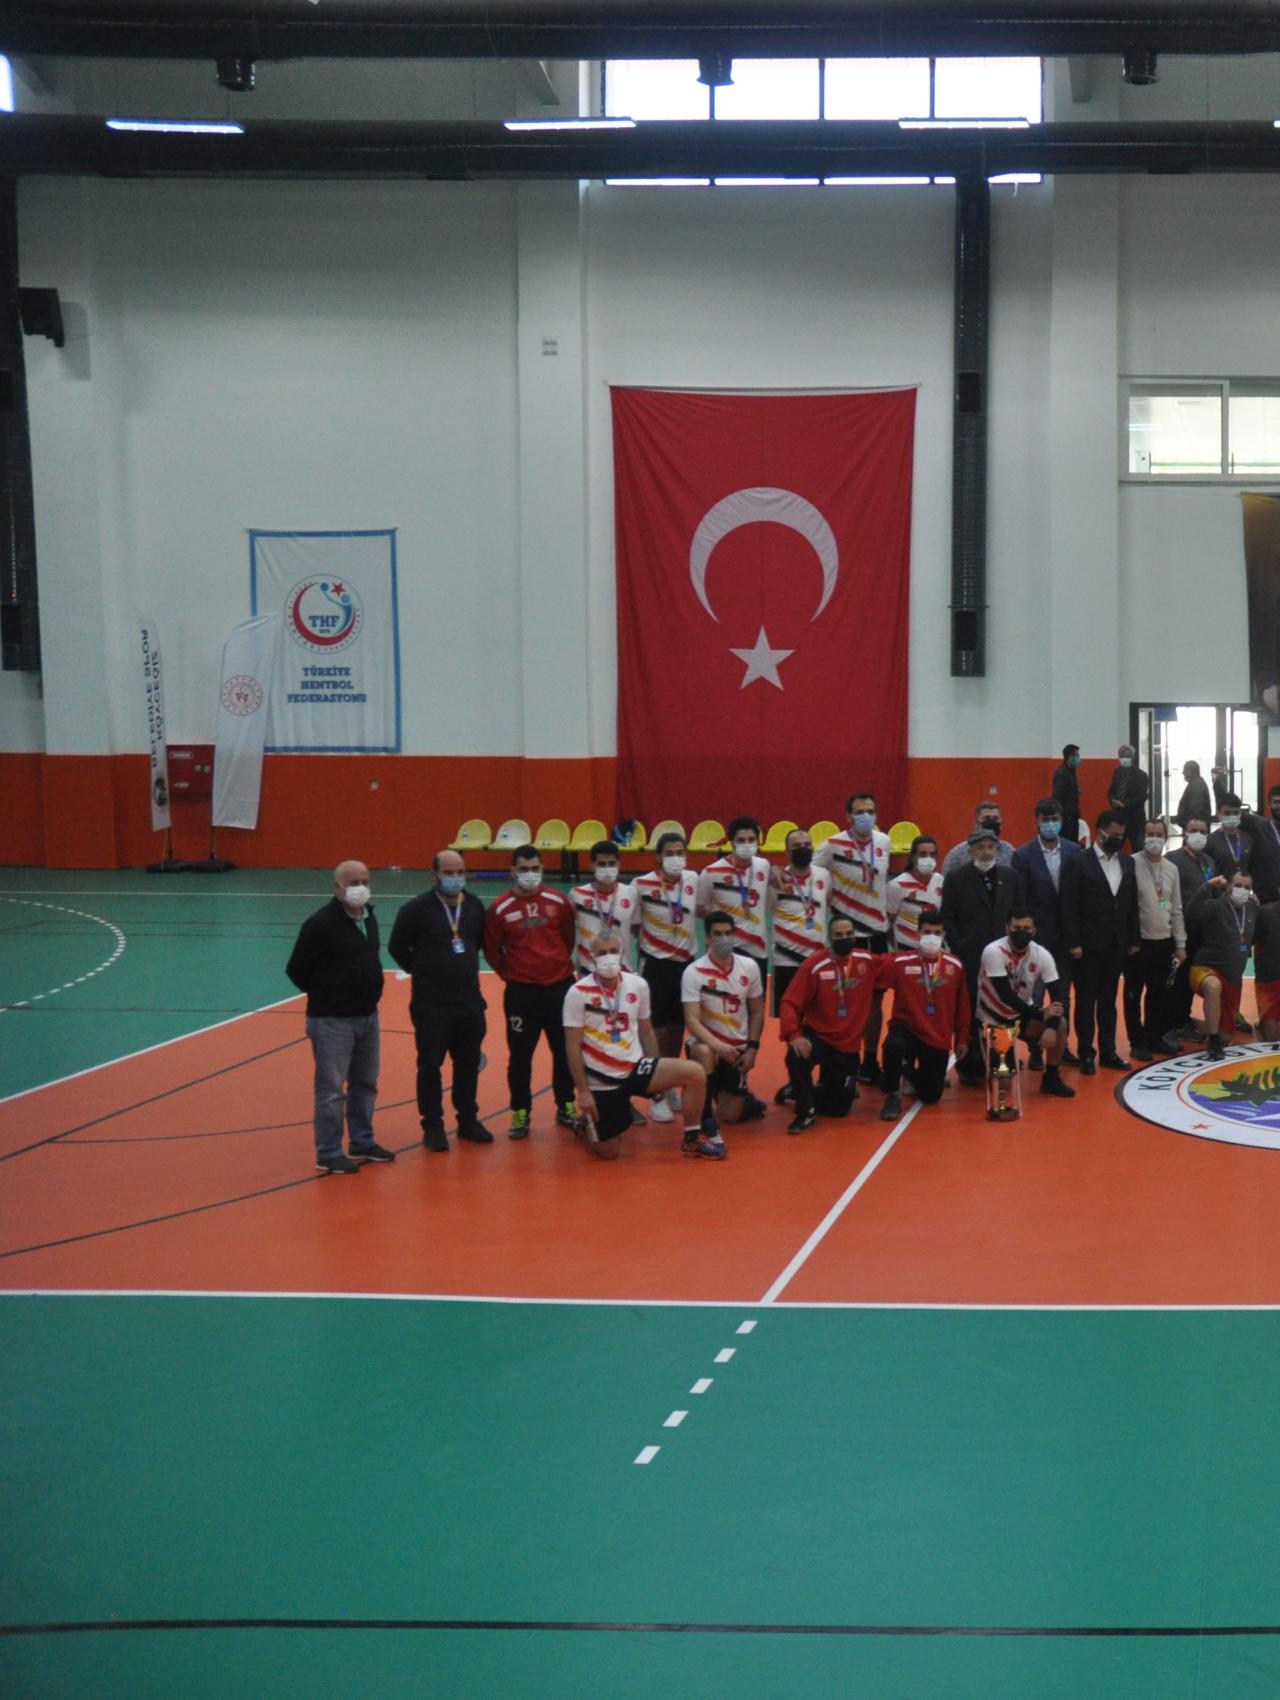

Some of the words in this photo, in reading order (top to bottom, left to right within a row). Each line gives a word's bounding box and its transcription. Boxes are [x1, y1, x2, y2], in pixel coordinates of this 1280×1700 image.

[308, 615, 340, 628] THF
[302, 665, 351, 676] TÜRKİYE
[300, 681, 354, 690] HENTBOL
[287, 693, 367, 703] FEDERASYONU
[526, 903, 539, 917] 12
[509, 1016, 523, 1032] 12
